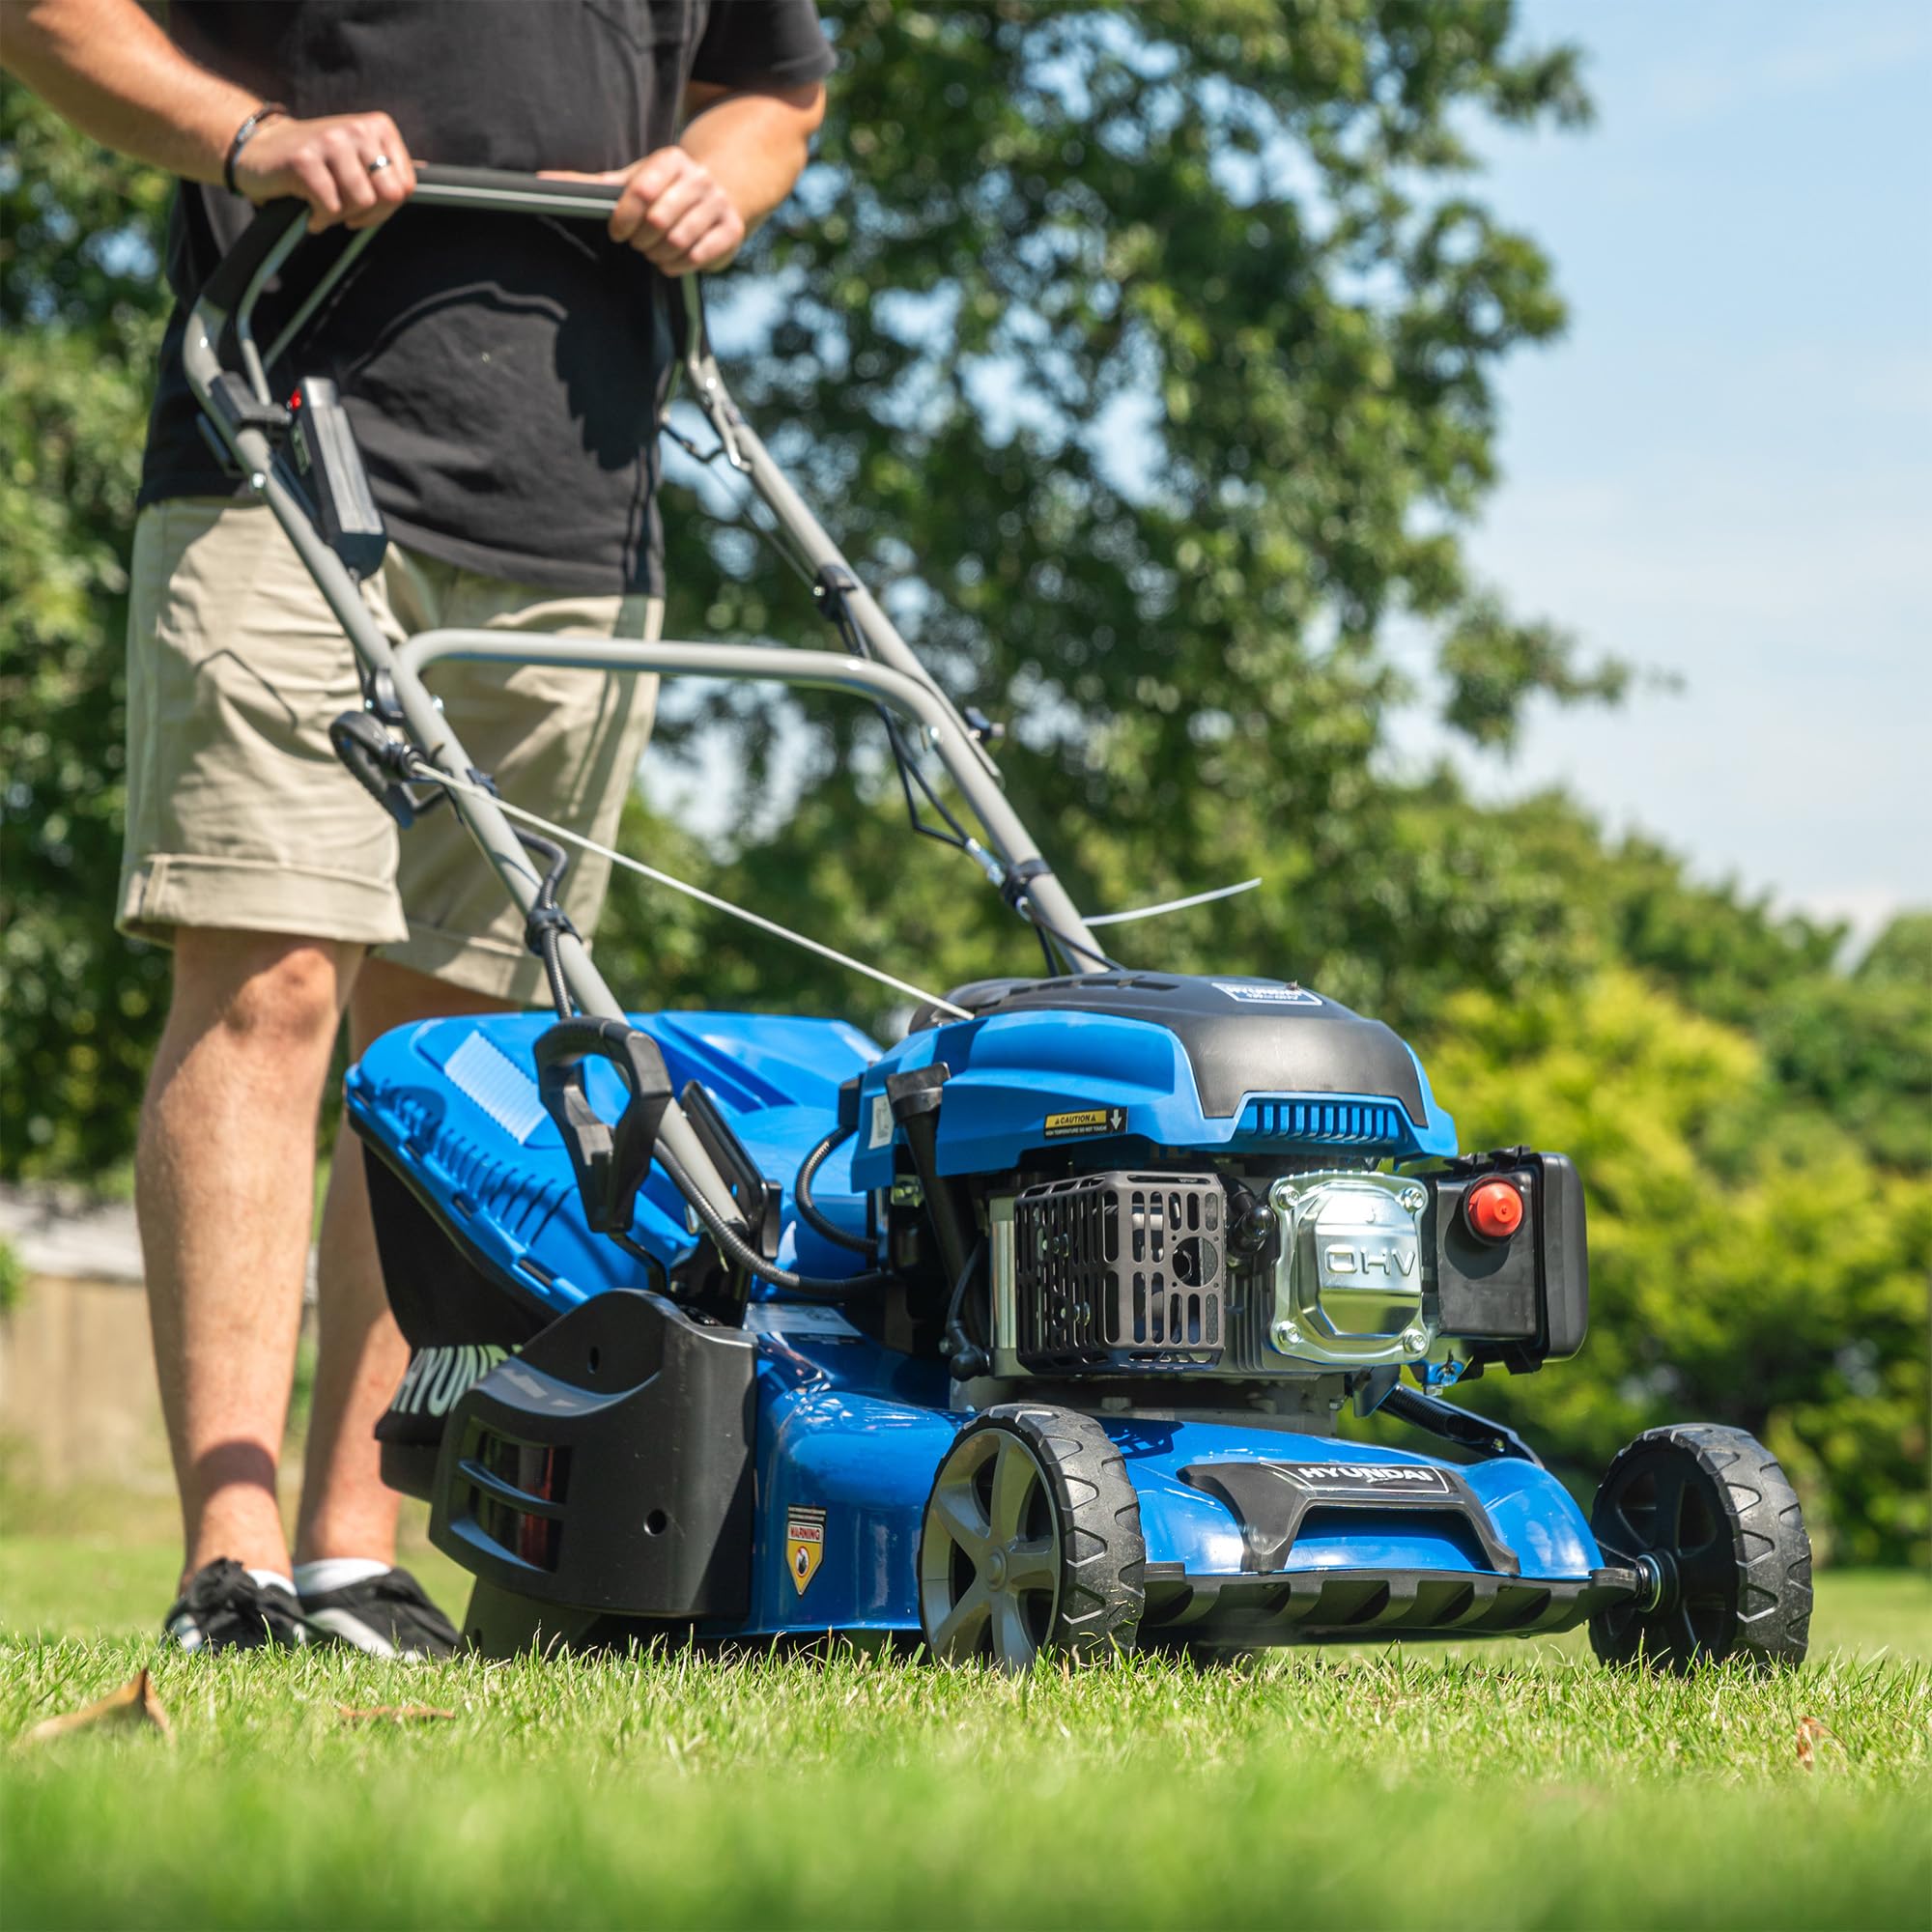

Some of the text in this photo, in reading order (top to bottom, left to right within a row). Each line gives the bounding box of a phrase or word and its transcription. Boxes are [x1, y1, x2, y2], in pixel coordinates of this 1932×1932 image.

[1060, 1114, 1091, 1124] CAUTION
[1324, 1244, 1415, 1276] OHV
[390, 1344, 523, 1417] HYUN
[1298, 1466, 1434, 1482] HYUNDAI
[790, 1526, 820, 1541] WARNING
